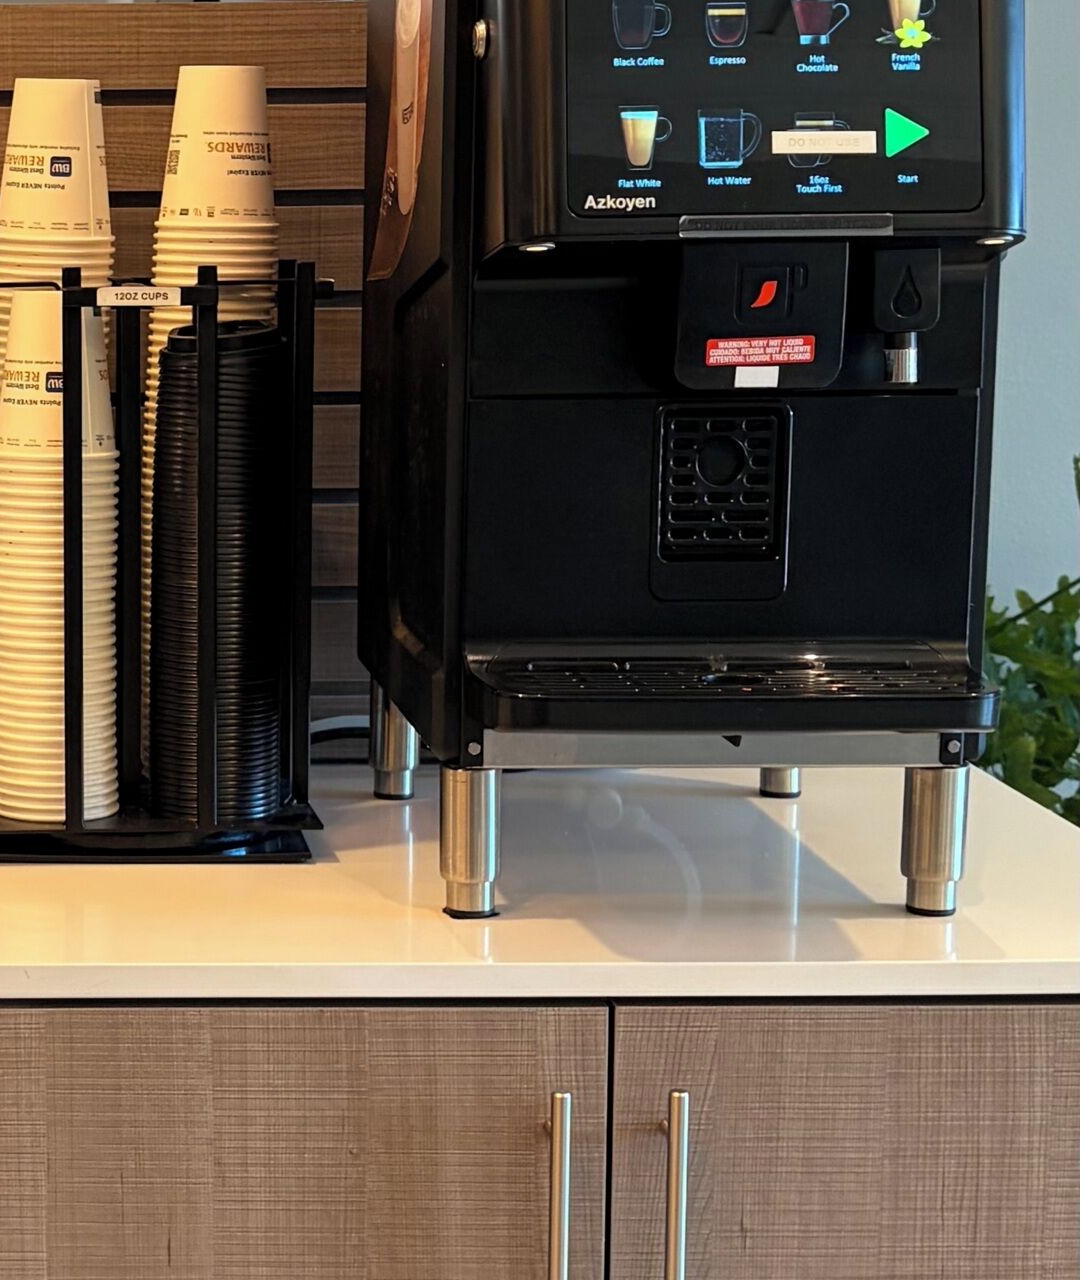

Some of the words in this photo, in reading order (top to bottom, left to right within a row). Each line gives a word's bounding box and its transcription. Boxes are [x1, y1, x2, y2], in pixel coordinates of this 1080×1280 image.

[613, 57, 636, 67] Black
[637, 57, 665, 67] Coffee
[709, 56, 746, 66] Espresso
[809, 54, 825, 63] Hot
[891, 53, 920, 62] French
[796, 63, 839, 72] Chocolate
[892, 62, 921, 71] Vanilla
[207, 141, 266, 153] REWARDS
[788, 137, 806, 148] DO
[51, 163, 70, 174] BW
[707, 177, 723, 186] Hot
[724, 176, 752, 186] Water
[897, 174, 919, 183] Start
[618, 179, 634, 188] Flat
[635, 179, 662, 188] White
[796, 184, 822, 193] Touch
[823, 183, 843, 193] First
[584, 194, 657, 212] Azkoyen
[114, 292, 139, 301] 12OZ
[141, 292, 169, 301] CUPS
[782, 345, 811, 353] CALIENTE
[39, 398, 62, 406] Points
